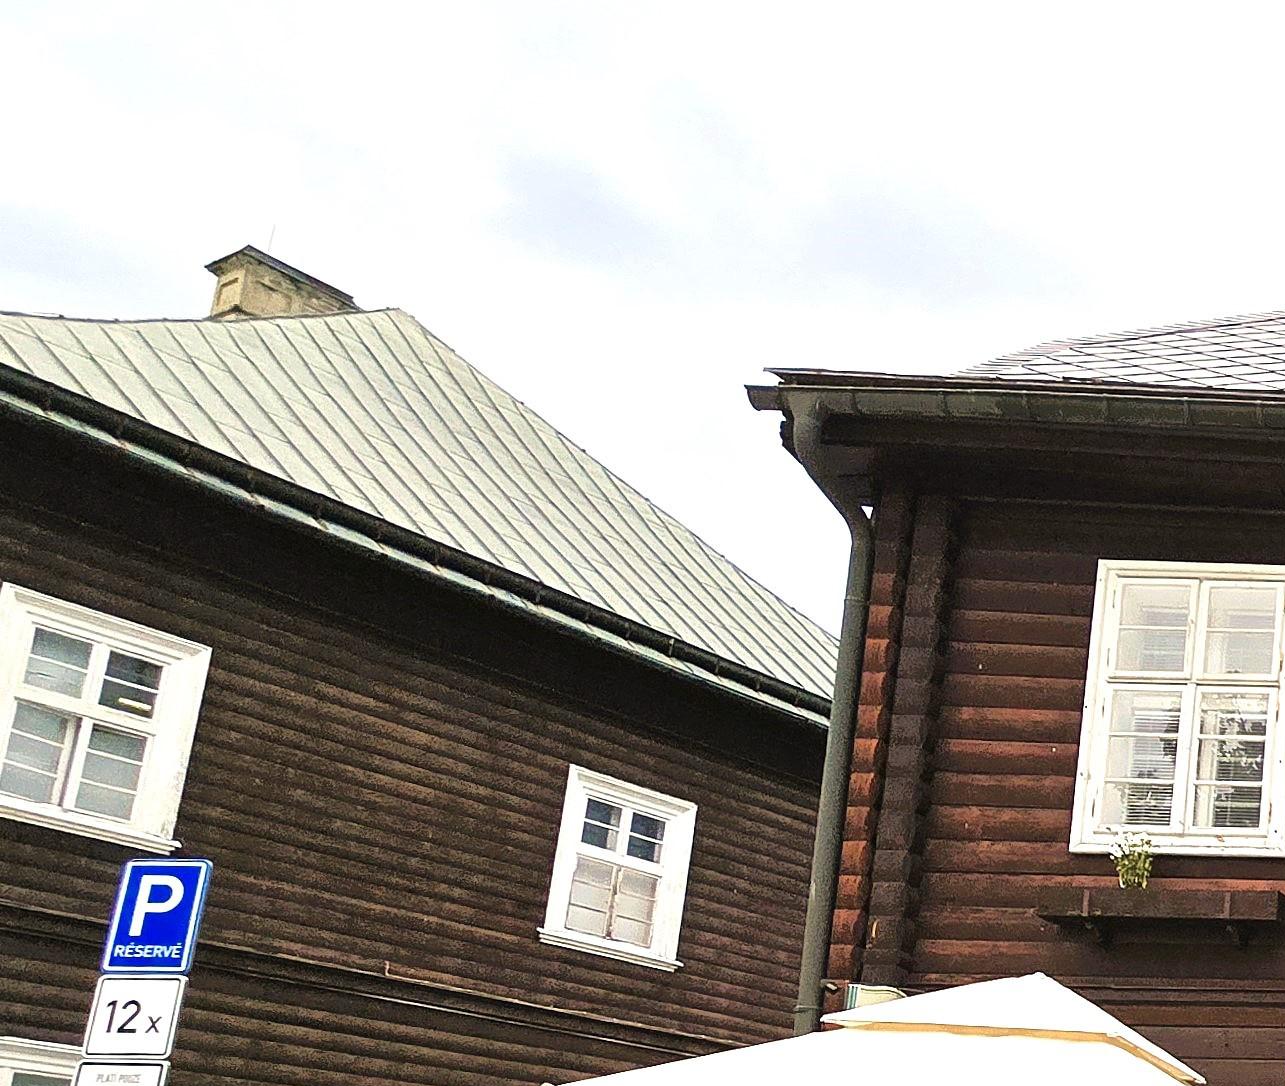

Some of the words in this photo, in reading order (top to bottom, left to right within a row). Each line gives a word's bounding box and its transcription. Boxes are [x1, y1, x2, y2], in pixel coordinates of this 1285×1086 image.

[128, 874, 185, 937] P
[105, 1000, 142, 1033] 12
[145, 1016, 162, 1033] x
